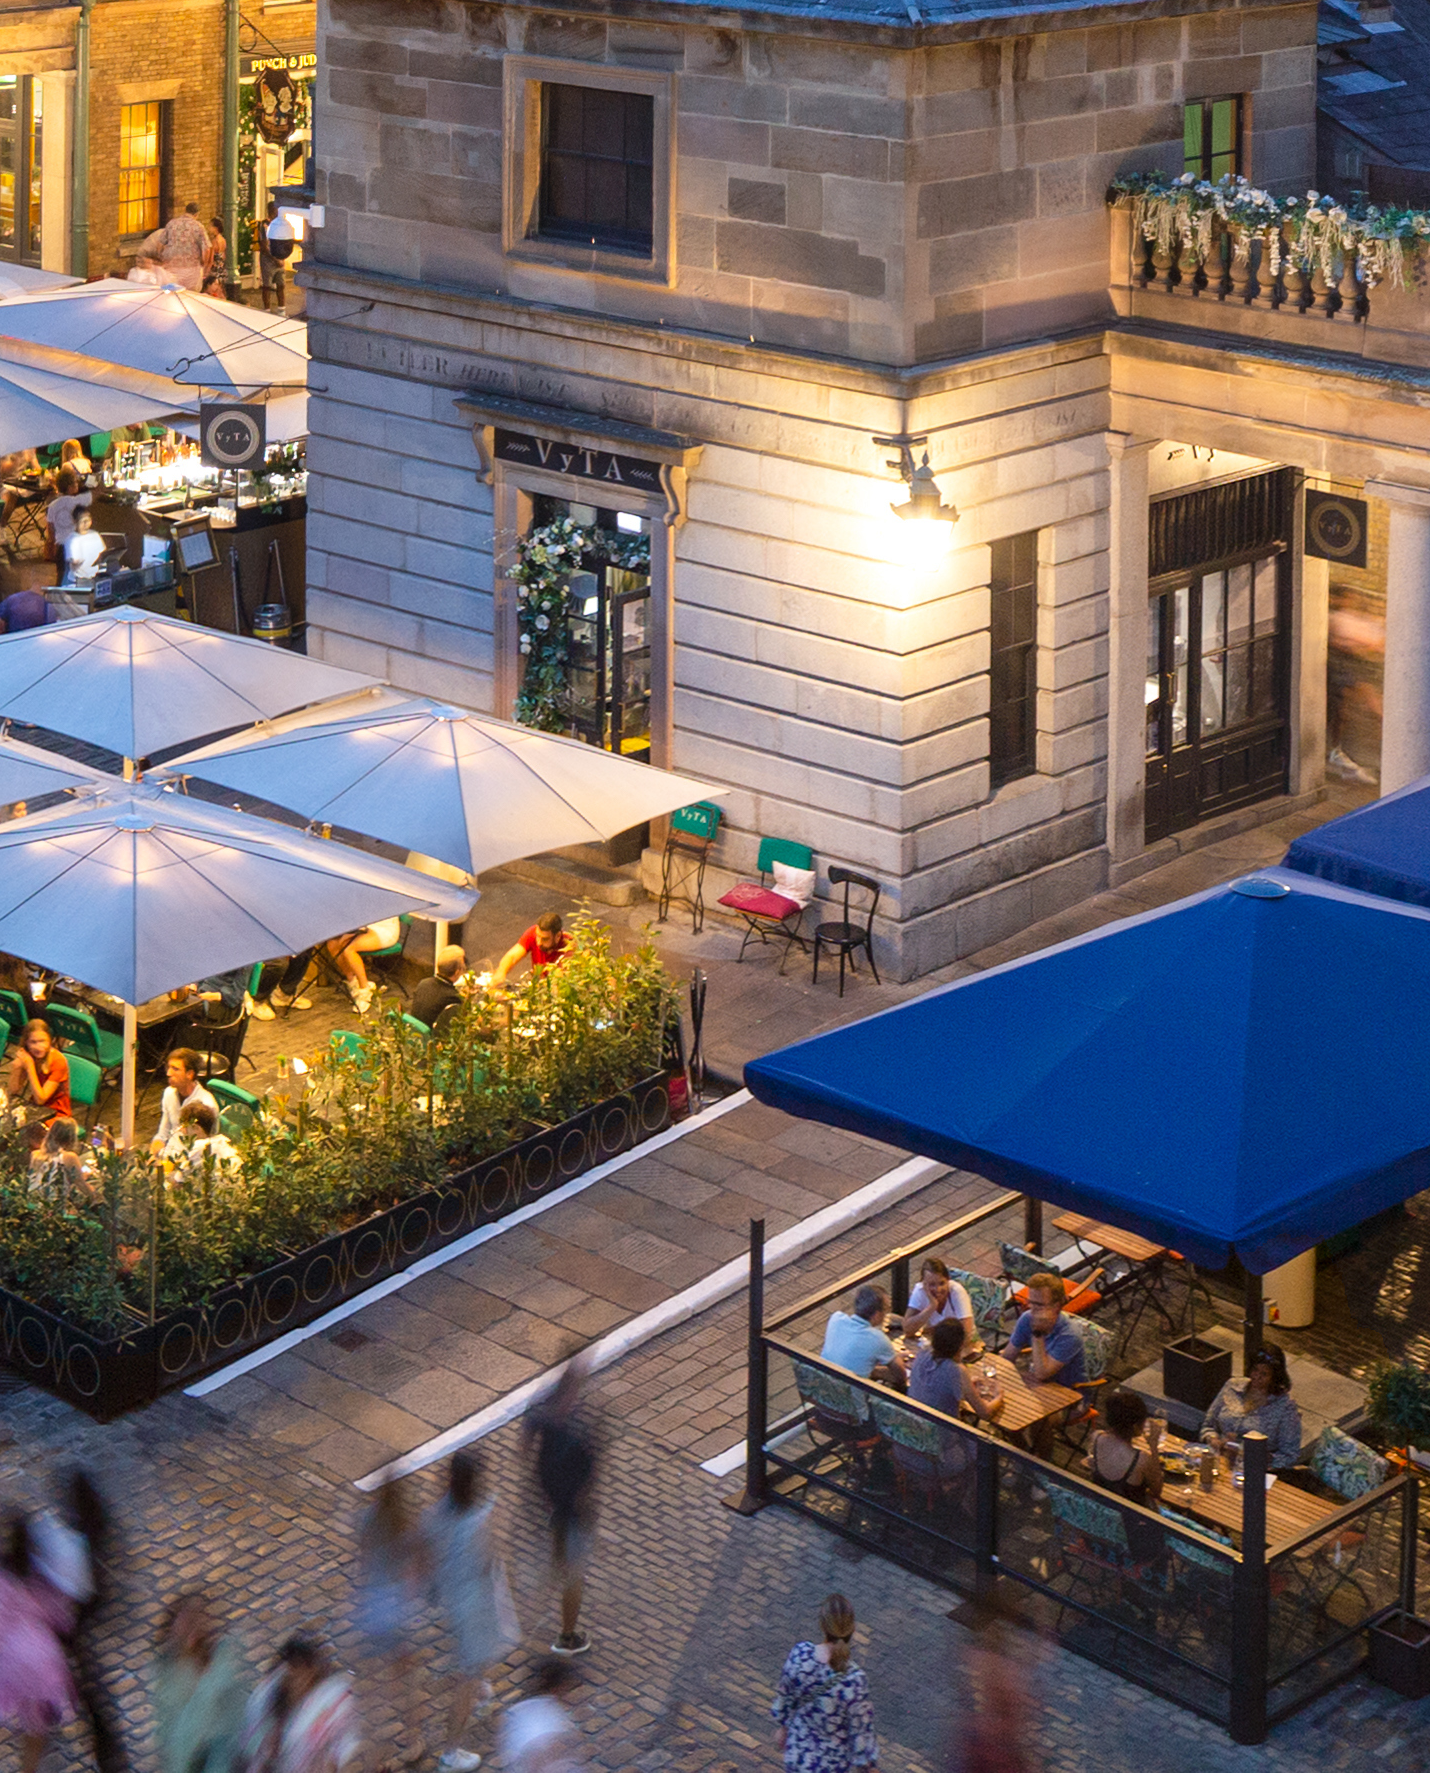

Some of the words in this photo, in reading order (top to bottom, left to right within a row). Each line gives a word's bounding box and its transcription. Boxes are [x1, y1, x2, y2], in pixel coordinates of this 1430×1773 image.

[251, 58, 287, 72] PUNCH
[288, 56, 298, 68] &
[298, 54, 317, 69] JUD
[534, 438, 625, 482] VyTA
